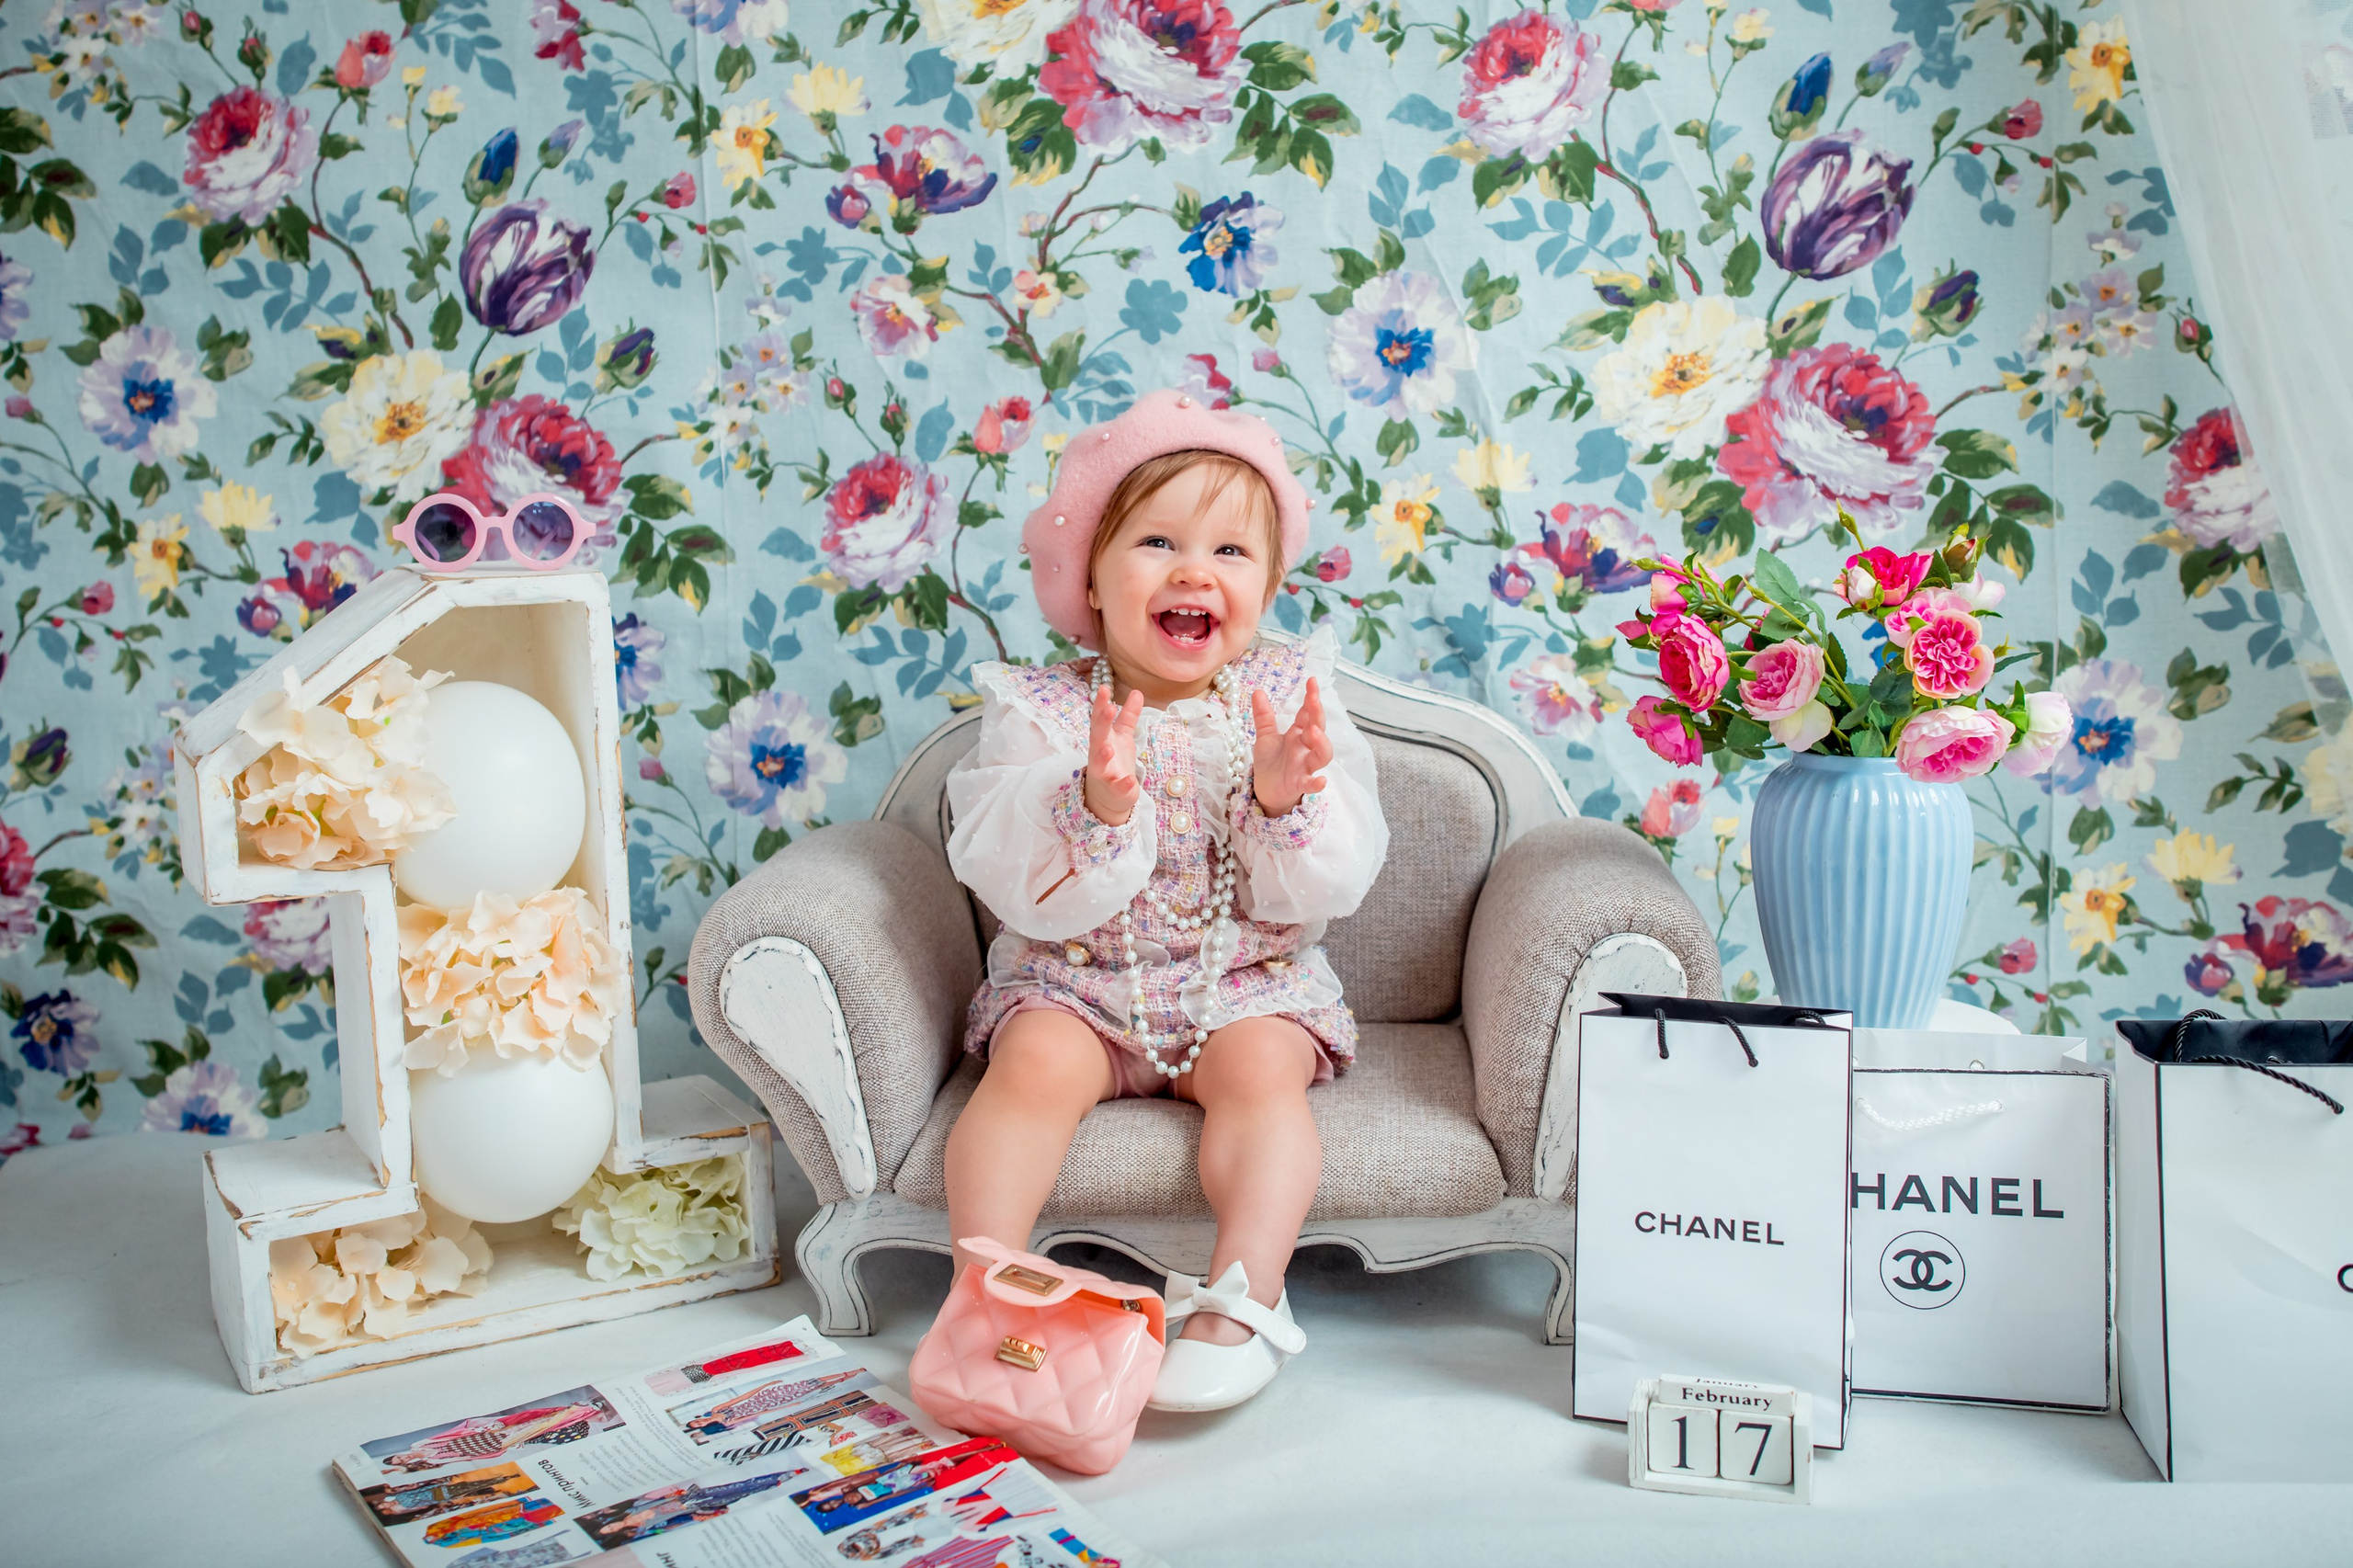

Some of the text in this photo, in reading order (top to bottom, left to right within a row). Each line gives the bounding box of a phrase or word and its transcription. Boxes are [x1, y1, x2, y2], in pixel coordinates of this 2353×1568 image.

[1850, 1172, 2065, 1219] HANEL
[1634, 1210, 1785, 1246] CHANEL
[1681, 1387, 1773, 1412] February
[538, 1459, 575, 1493] принтов
[567, 1490, 597, 1510] Микс
